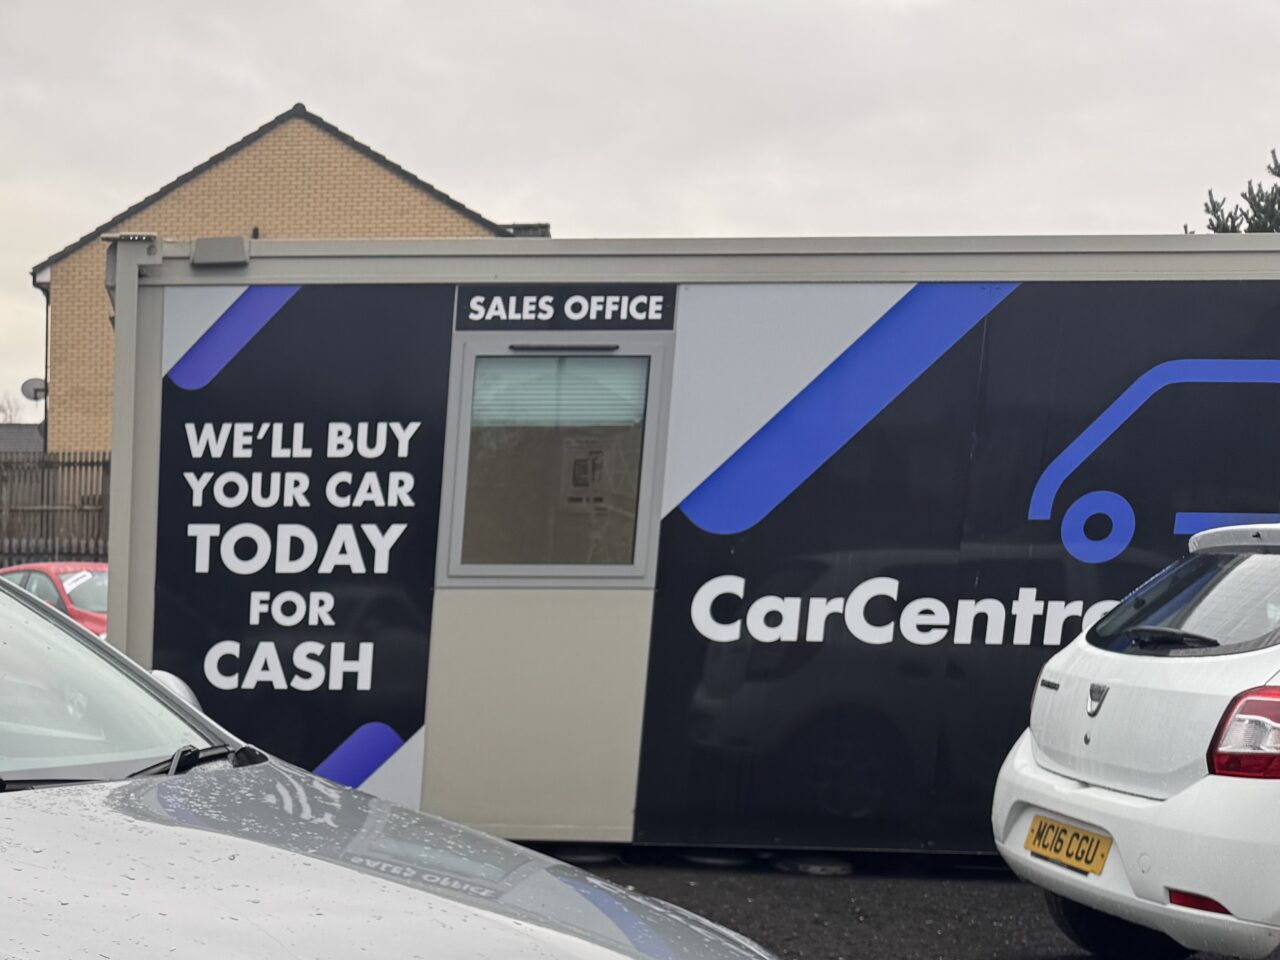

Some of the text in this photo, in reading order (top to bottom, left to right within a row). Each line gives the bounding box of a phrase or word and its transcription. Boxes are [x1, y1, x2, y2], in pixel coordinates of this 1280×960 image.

[468, 295, 664, 322] SALES OFFICE
[184, 422, 422, 459] WE'LL BUY
[183, 471, 415, 508] YOUR CAR
[187, 522, 408, 575] TODAY
[248, 590, 336, 627] FOR
[203, 640, 375, 692] CASH
[1065, 832, 1101, 865] CGU
